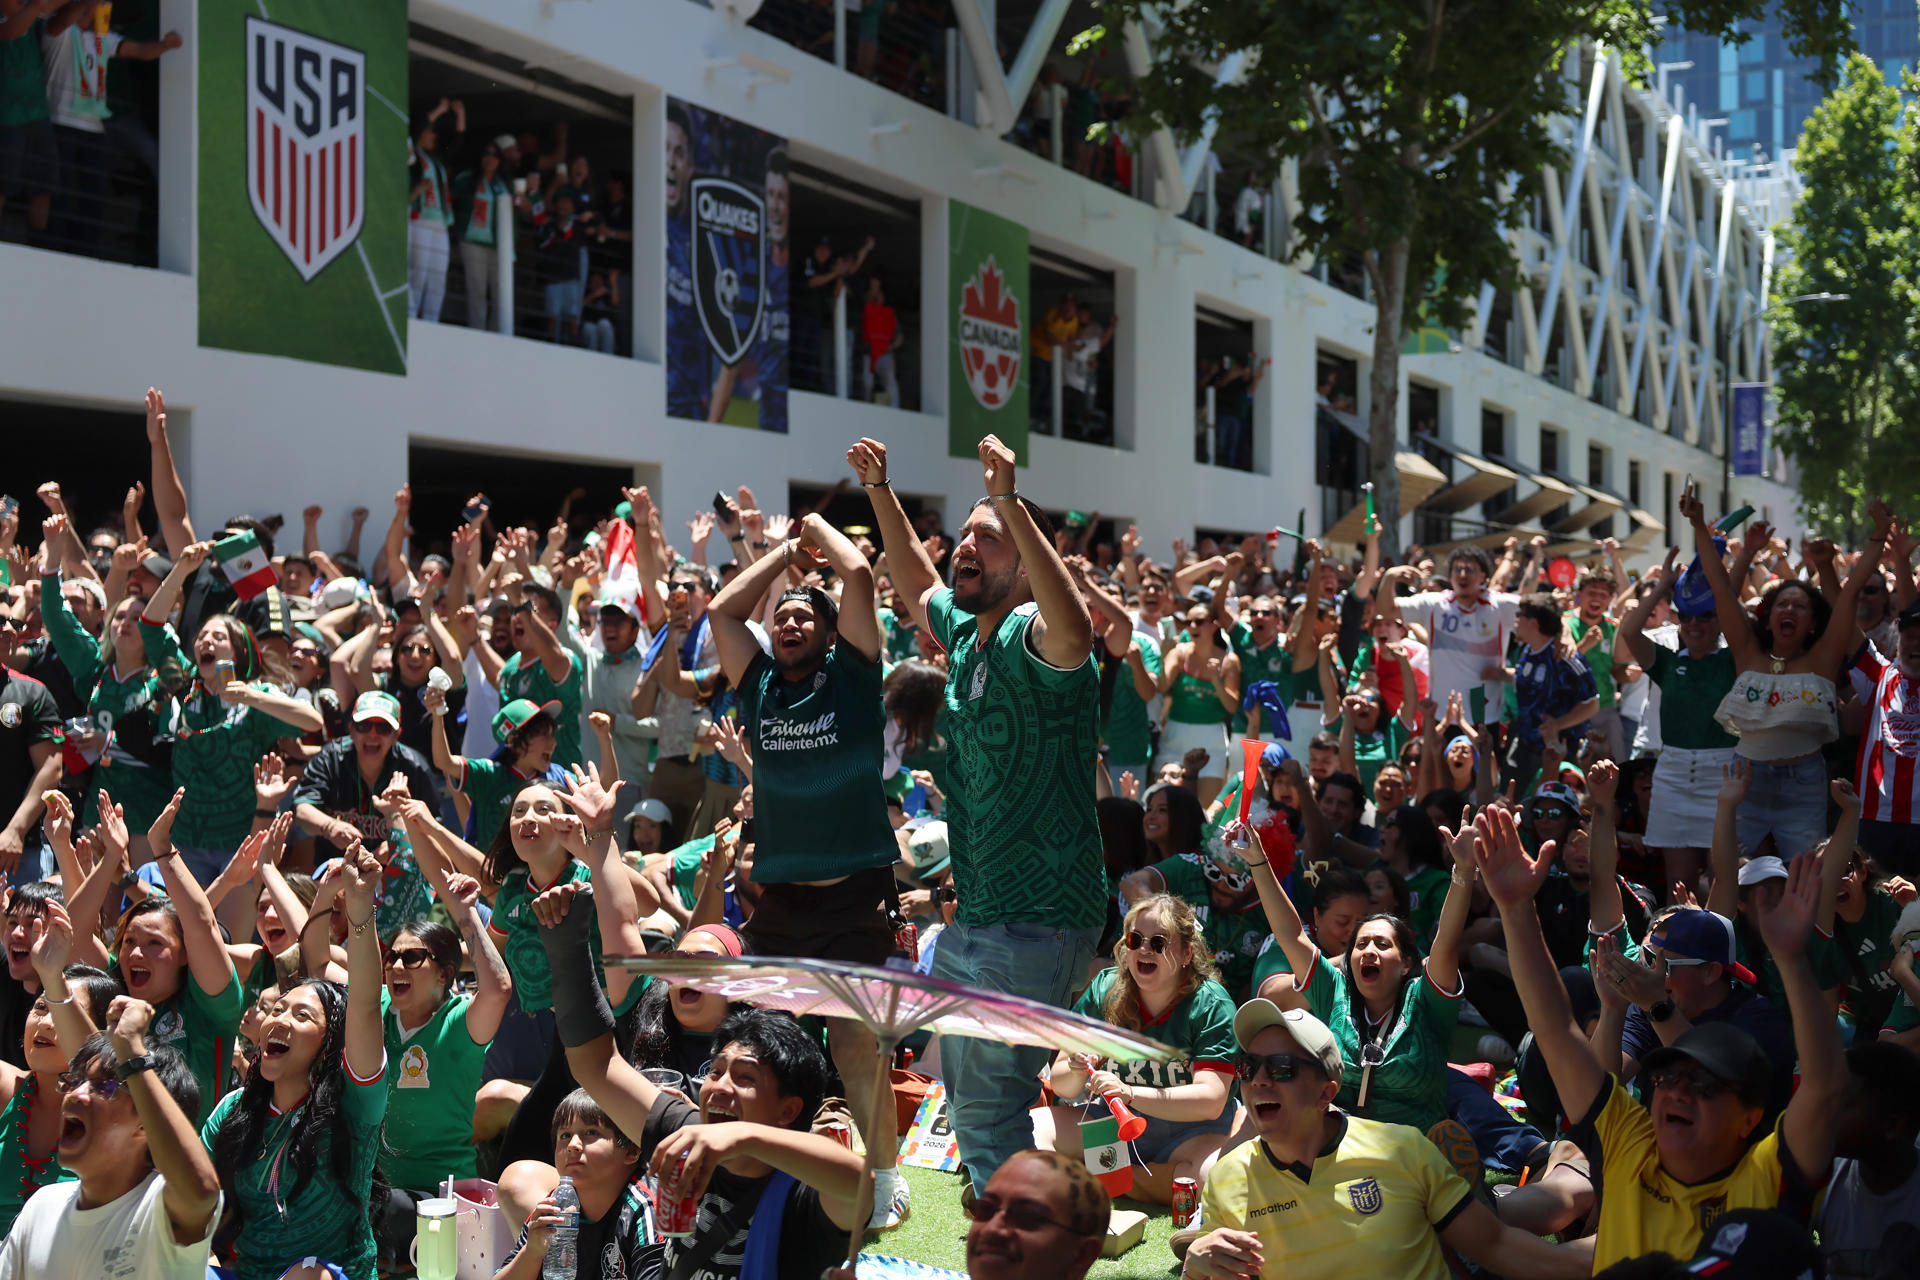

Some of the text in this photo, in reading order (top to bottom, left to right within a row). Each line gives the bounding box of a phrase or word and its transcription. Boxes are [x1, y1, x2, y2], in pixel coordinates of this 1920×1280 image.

[256, 34, 357, 138] USA
[698, 191, 759, 235] QUAKES
[960, 319, 1021, 353] CANADA
[1441, 612, 1459, 633] 10
[761, 732, 839, 751] caliente.mx
[1105, 1056, 1194, 1088] EXIC
[923, 1140, 946, 1149] 2026
